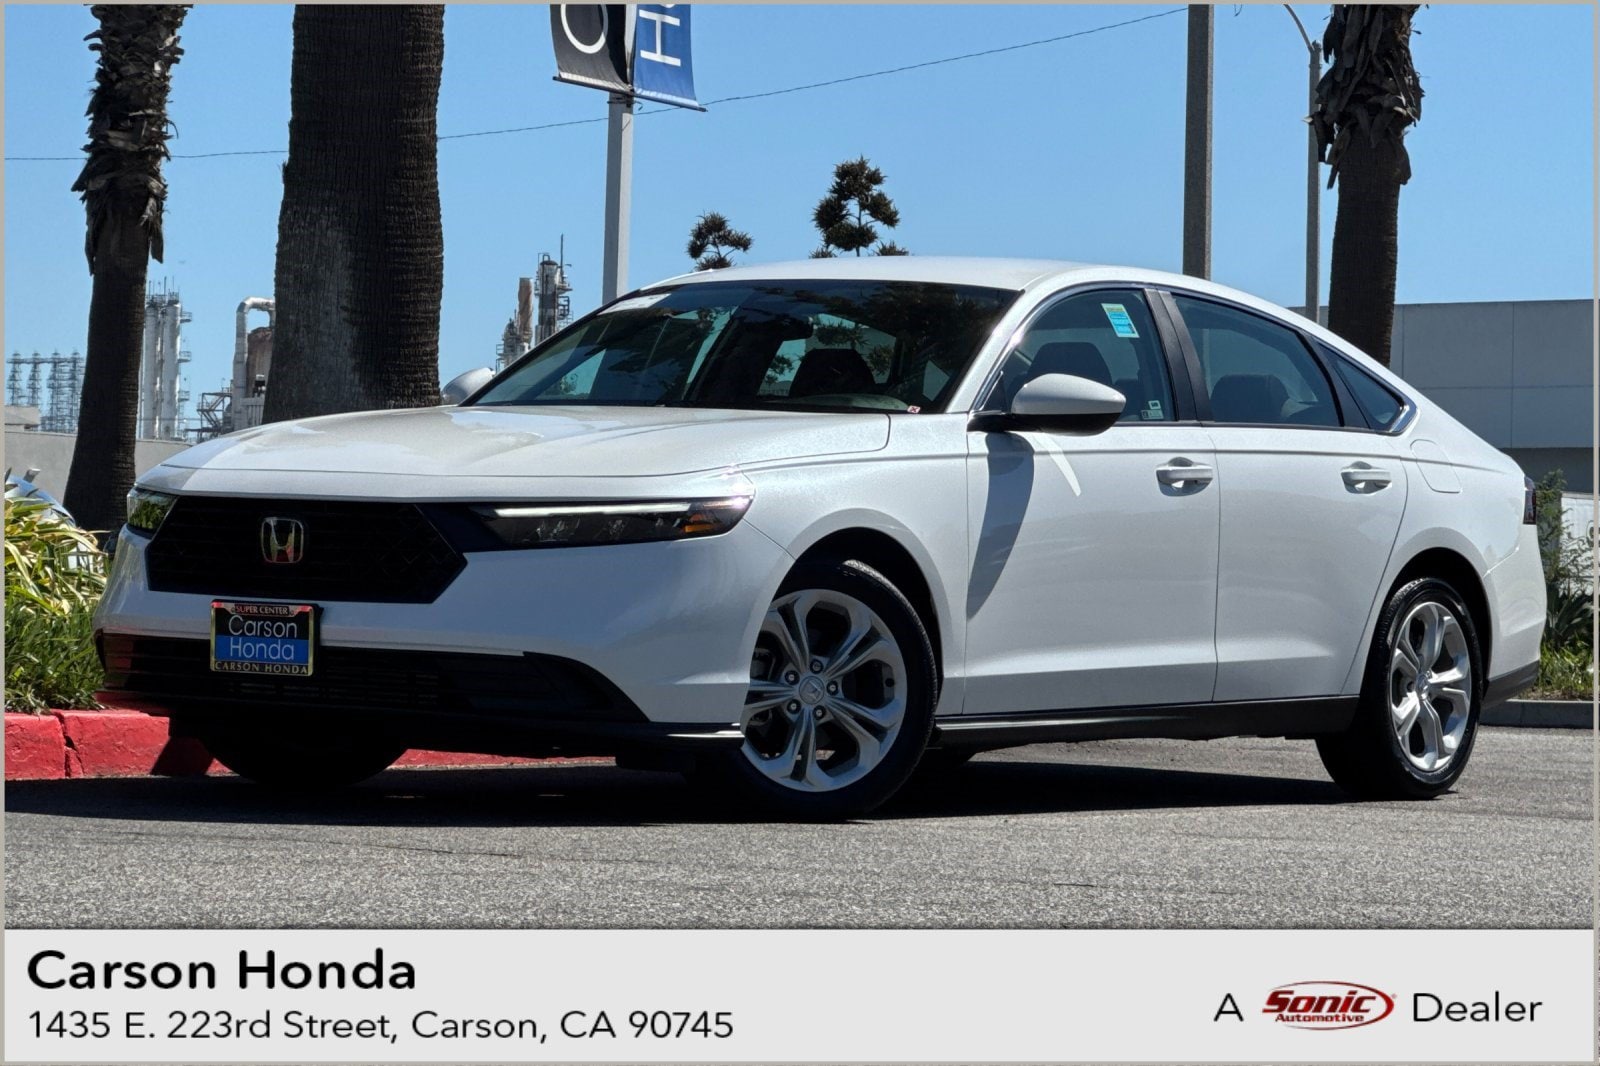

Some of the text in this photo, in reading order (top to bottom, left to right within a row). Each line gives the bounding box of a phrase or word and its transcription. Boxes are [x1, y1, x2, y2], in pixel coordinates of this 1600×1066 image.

[638, 4, 681, 67] H
[235, 605, 289, 615] SUPER CENTER
[228, 614, 298, 639] Carson
[229, 637, 295, 661] Honda
[215, 661, 308, 675] CARSON HONDA
